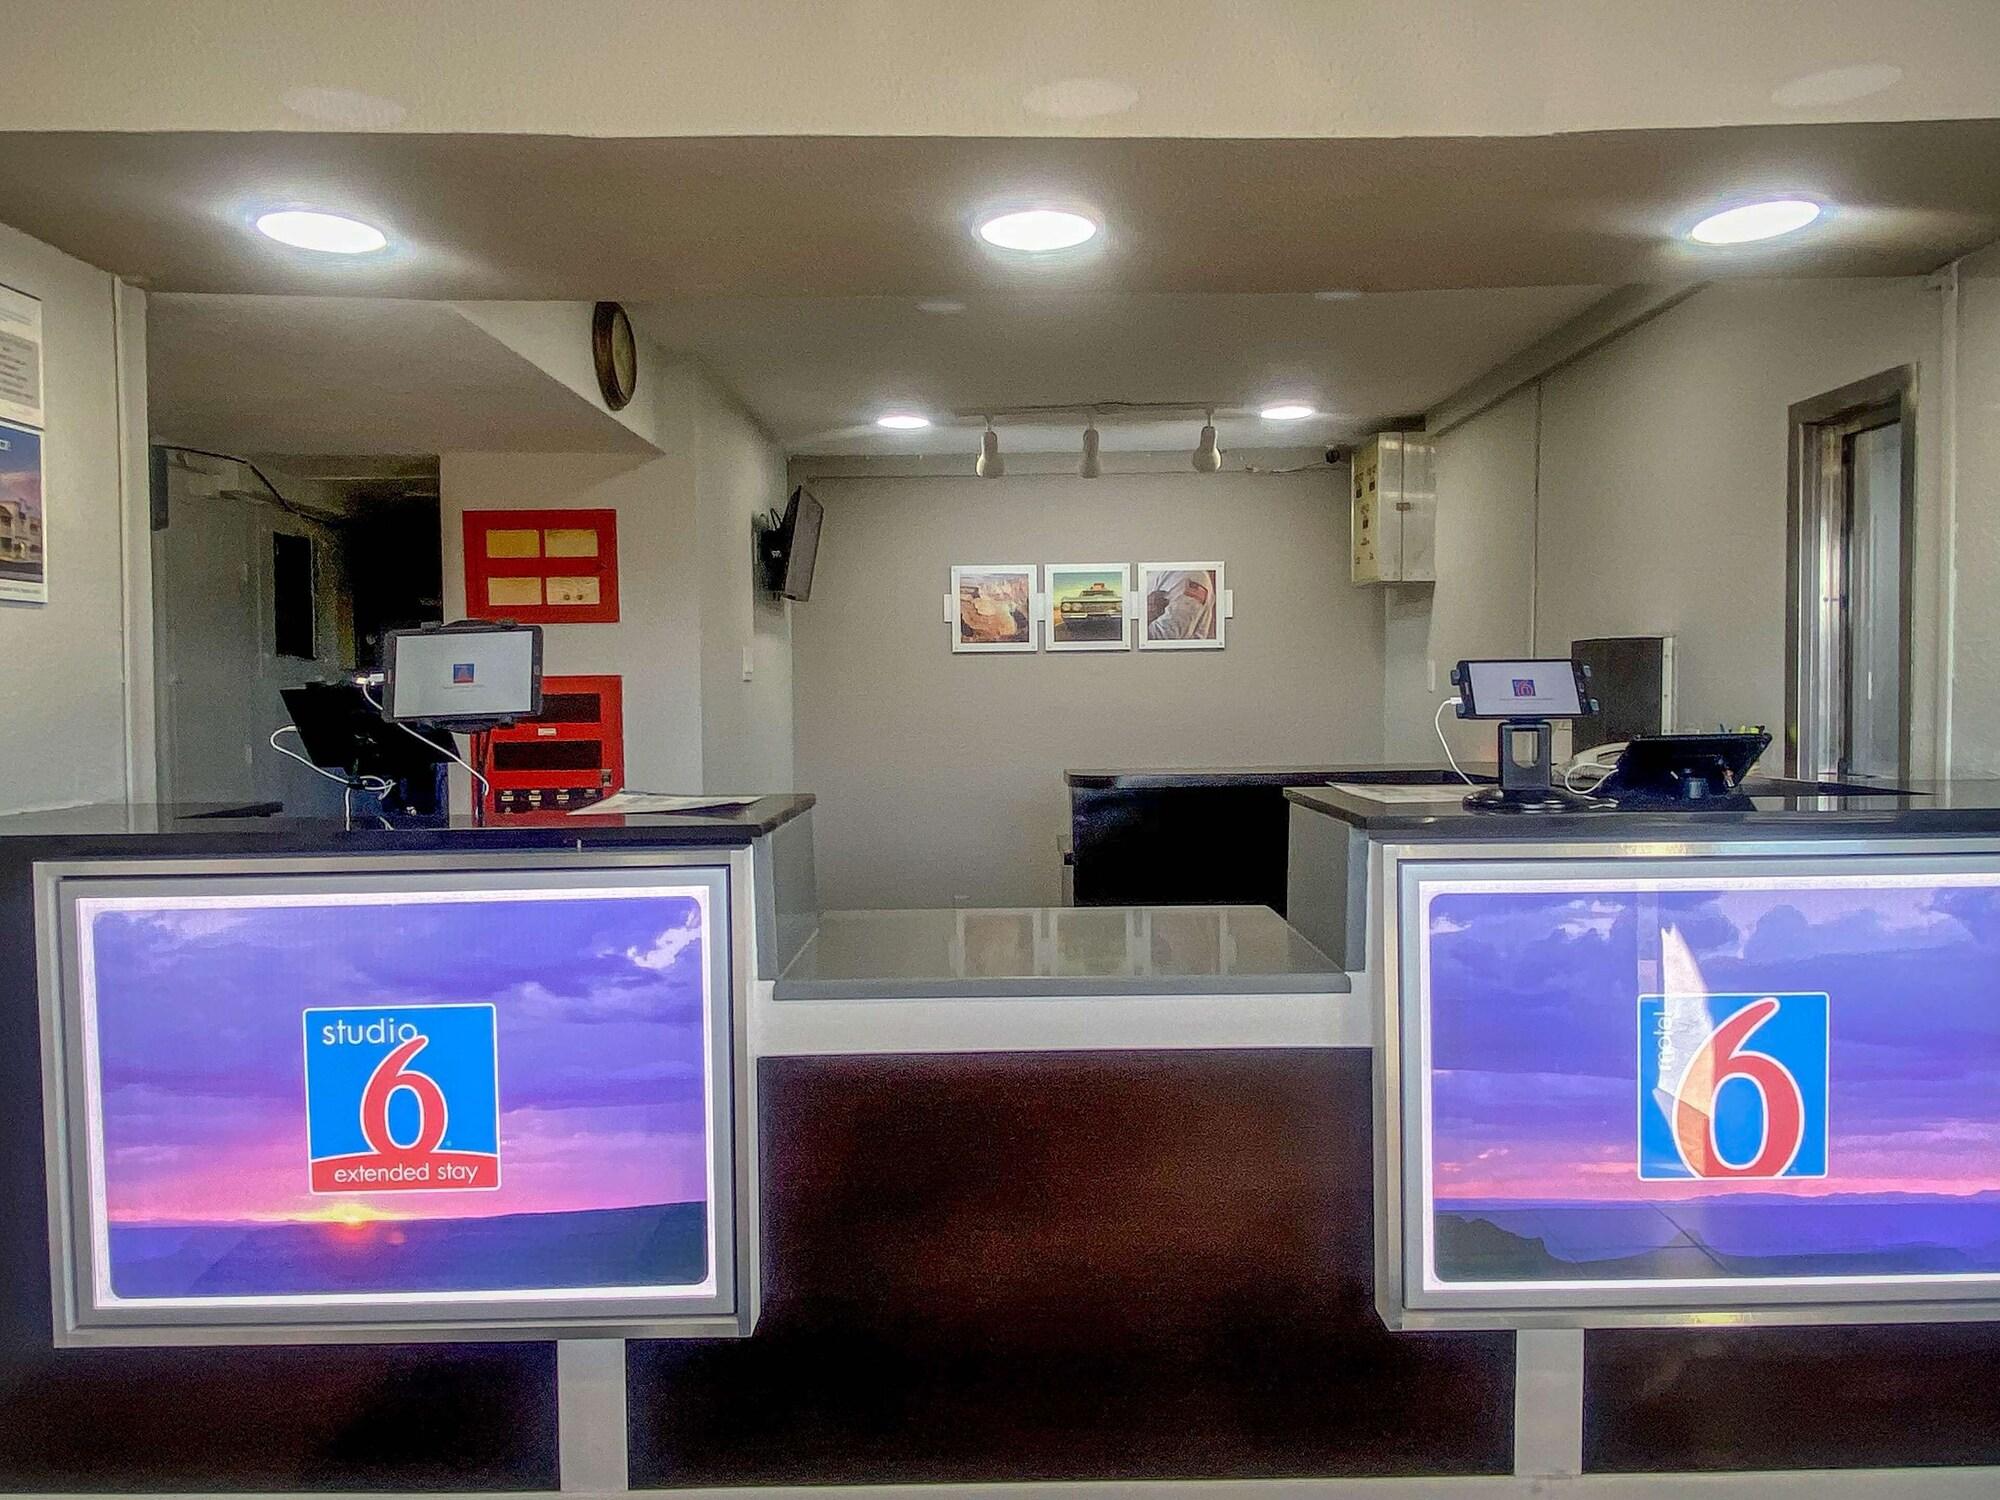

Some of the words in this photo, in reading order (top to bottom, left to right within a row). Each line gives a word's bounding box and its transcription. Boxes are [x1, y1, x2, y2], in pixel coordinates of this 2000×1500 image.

[322, 1017, 417, 1046] studio
[1653, 1011, 1673, 1070] motel
[360, 1034, 448, 1152] 6
[1672, 997, 1804, 1179] 6
[334, 1163, 430, 1183] extended
[437, 1164, 478, 1183] stay
